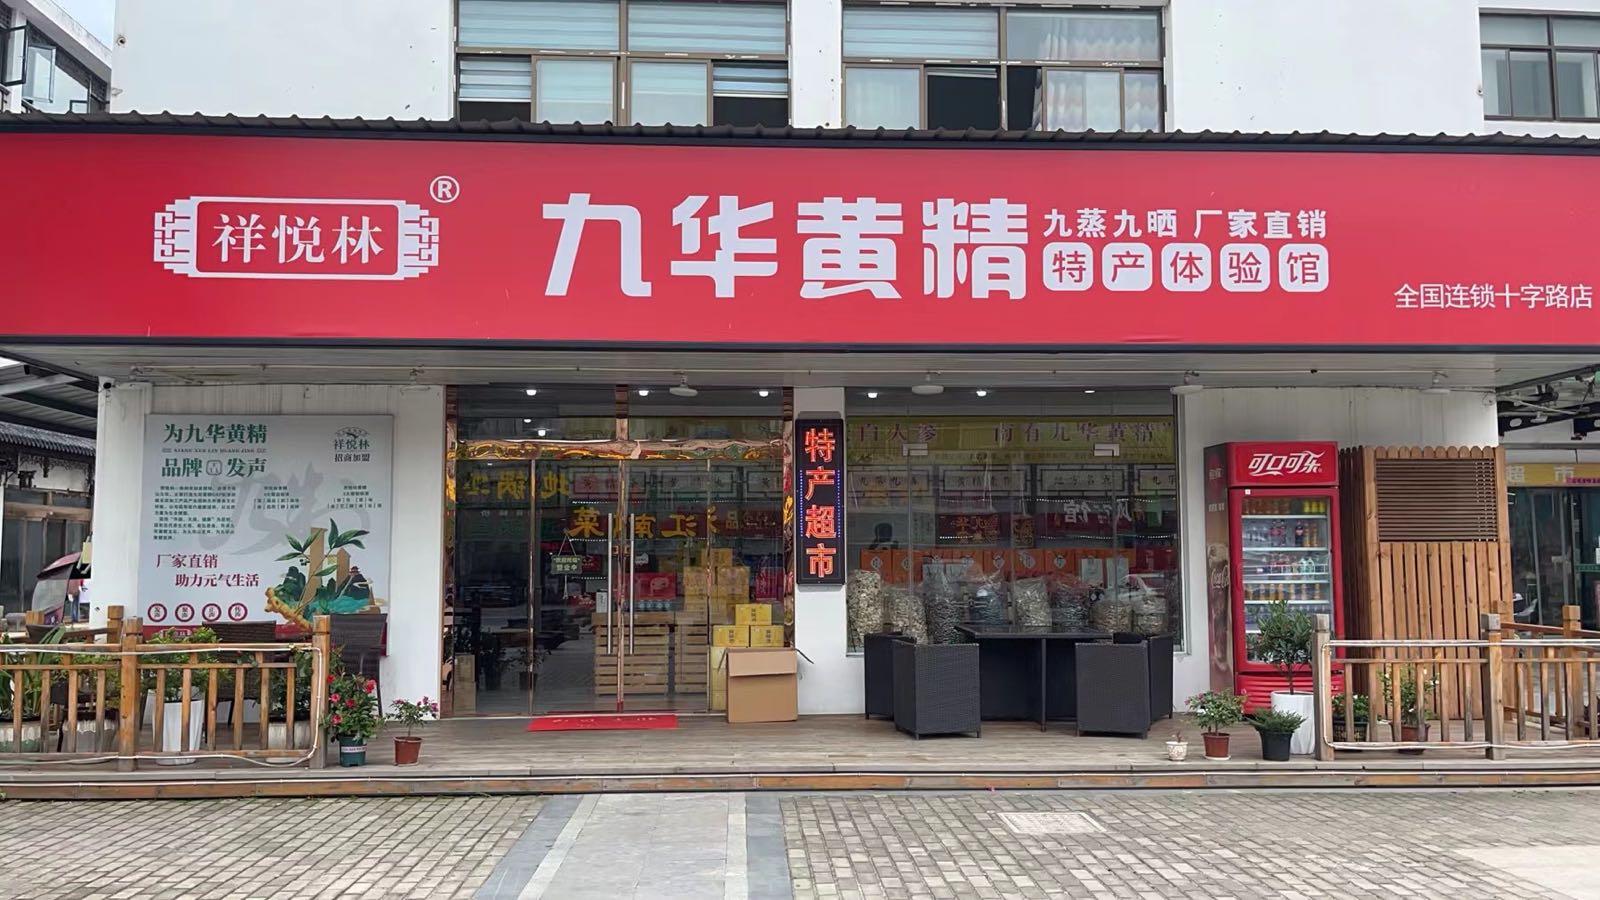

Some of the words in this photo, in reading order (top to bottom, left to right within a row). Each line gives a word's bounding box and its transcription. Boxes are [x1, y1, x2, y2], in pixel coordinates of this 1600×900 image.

[1043, 208, 1177, 238] 九蒸九晒
[1193, 209, 1327, 239] 厂家直销
[212, 213, 384, 263] 祥悦林
[542, 193, 1028, 299] 九华黄精
[1049, 248, 1322, 287] 特产体验馆
[1393, 283, 1593, 309] 全国连锁十字路店
[163, 423, 267, 443] 为九华黄精
[334, 439, 370, 450] 祥悦林
[161, 458, 202, 477] 品牌
[226, 458, 267, 477] 发声
[335, 453, 370, 462] 招商加盟
[1248, 450, 1325, 476] 可口可乐
[804, 428, 837, 577] 特产超市
[157, 553, 218, 568] 厂家直销
[175, 573, 260, 587] 助力元气生活
